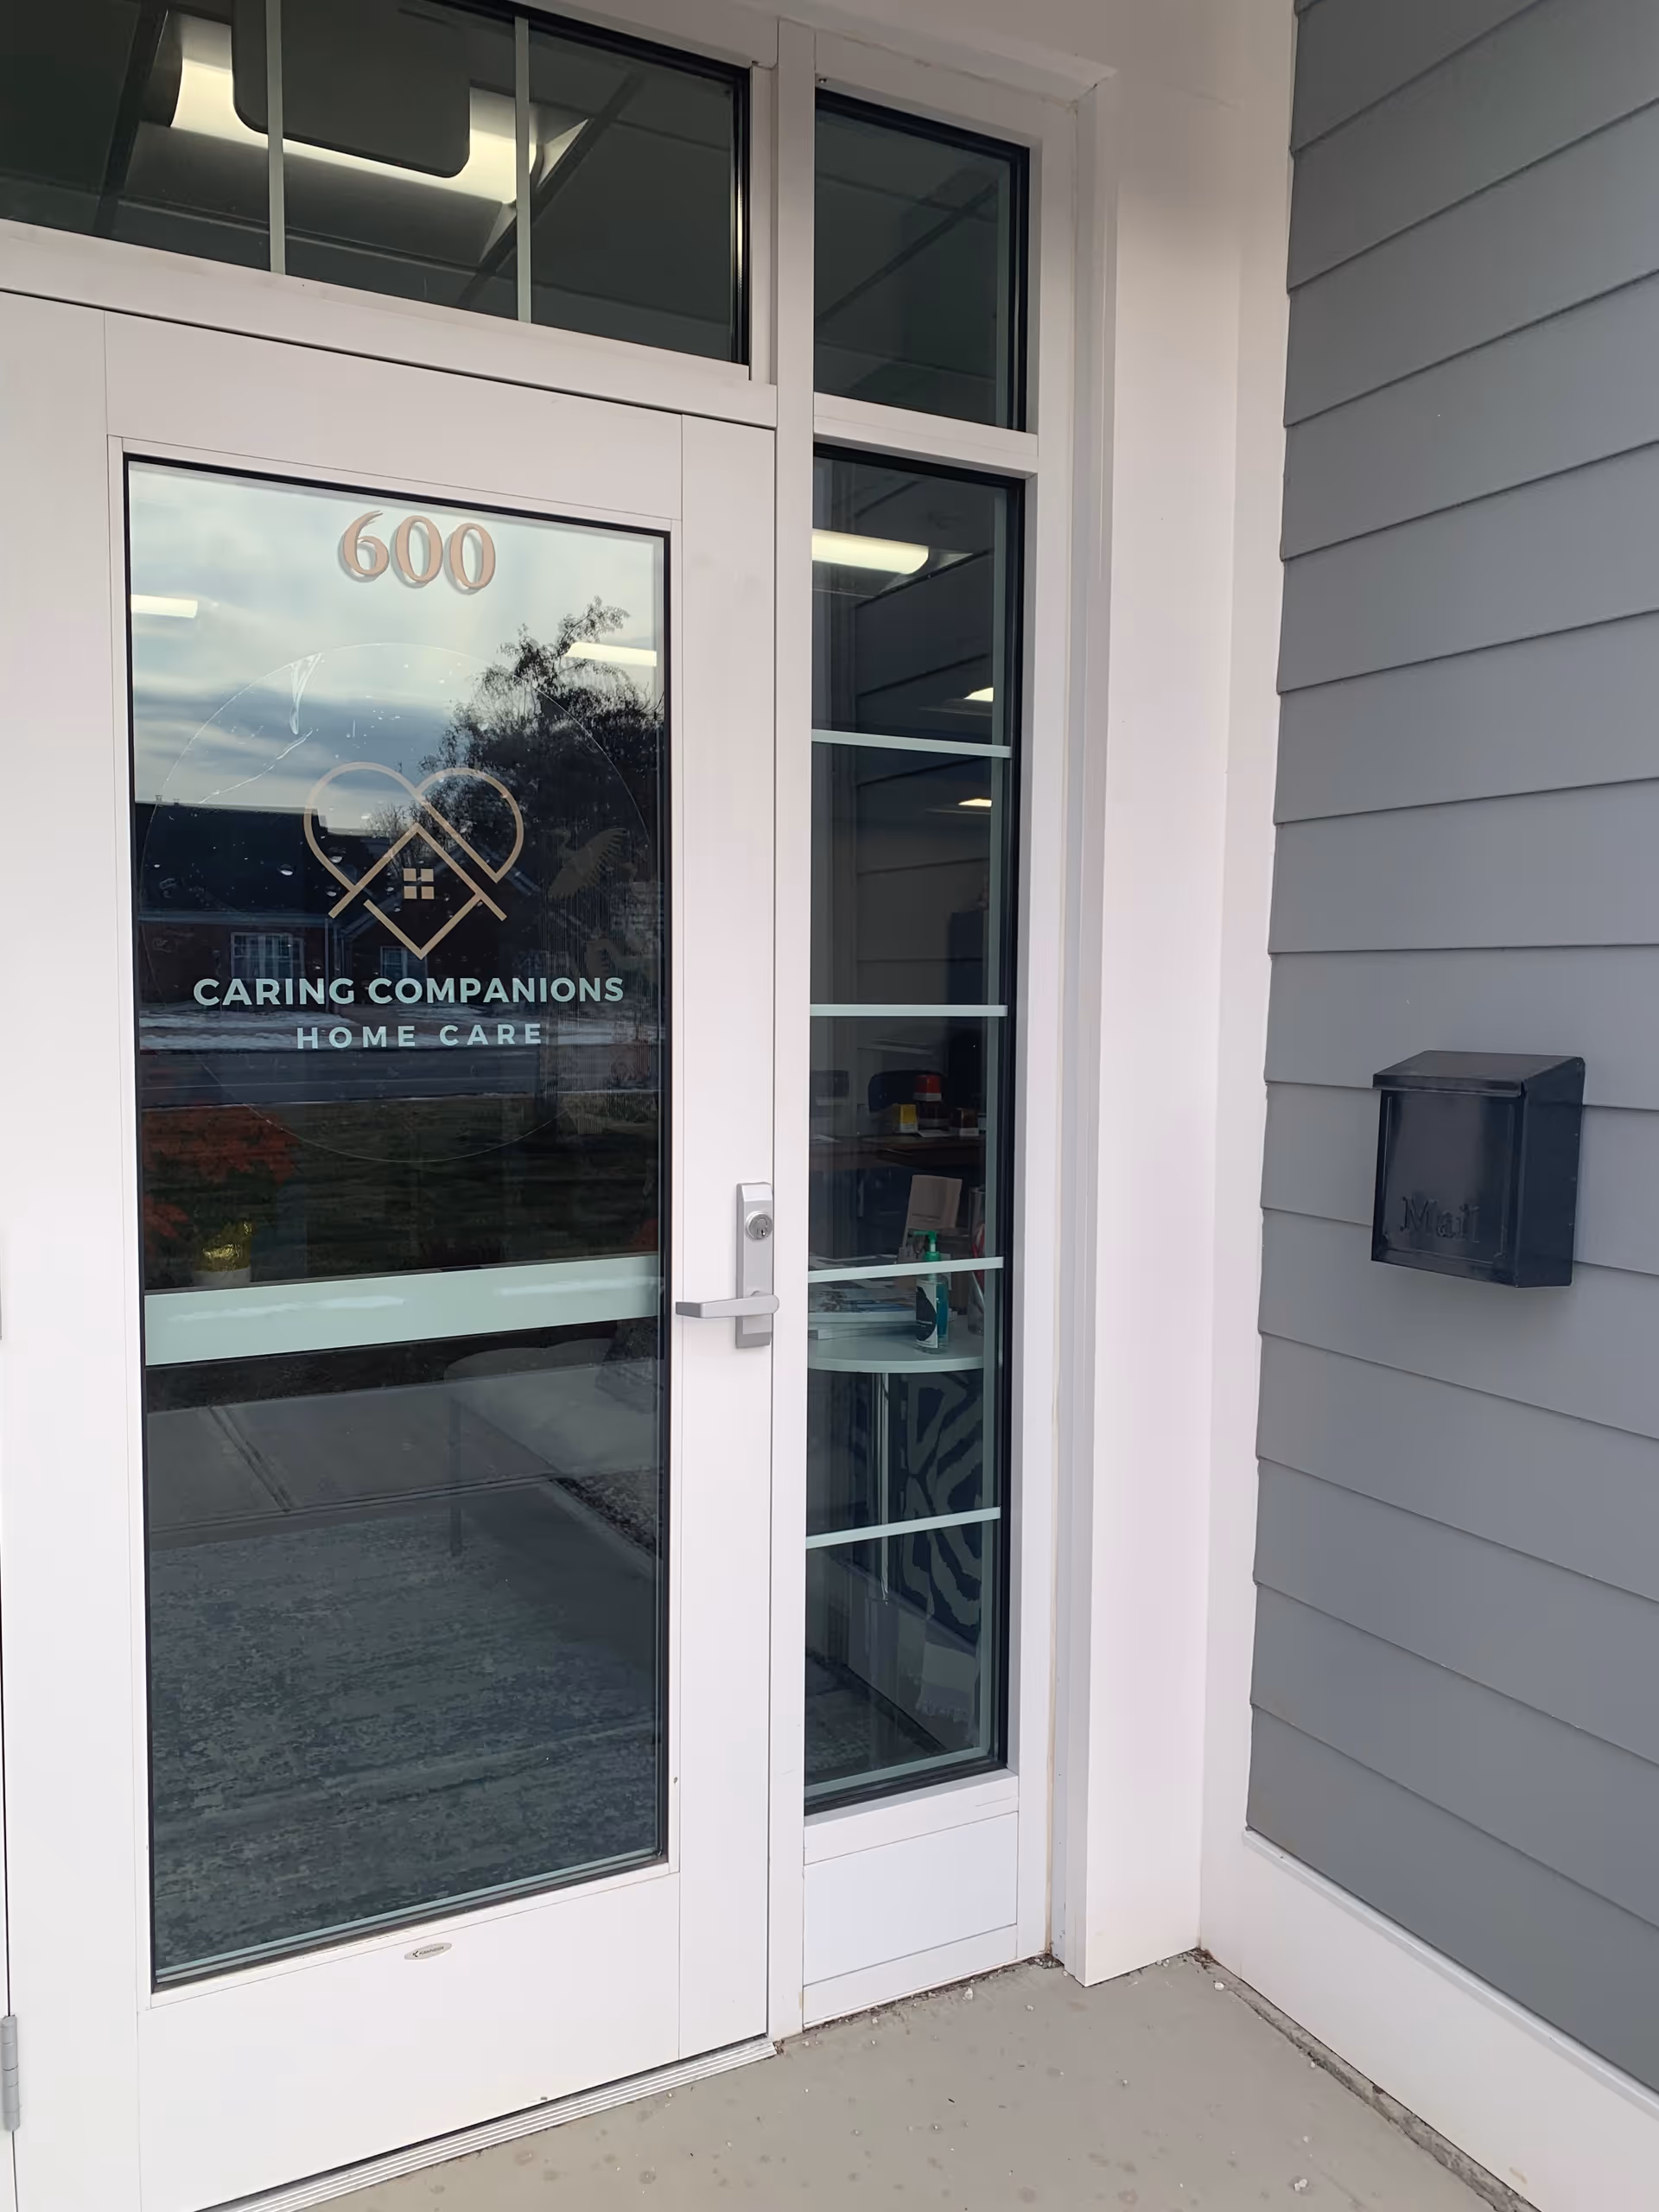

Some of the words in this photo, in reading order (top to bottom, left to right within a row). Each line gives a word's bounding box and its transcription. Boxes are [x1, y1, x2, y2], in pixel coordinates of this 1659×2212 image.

[340, 510, 496, 590] 600
[194, 978, 354, 1005] CARING
[367, 977, 624, 1004] COMPANIONS
[296, 1026, 416, 1049] HOME
[439, 1023, 542, 1046] CARE
